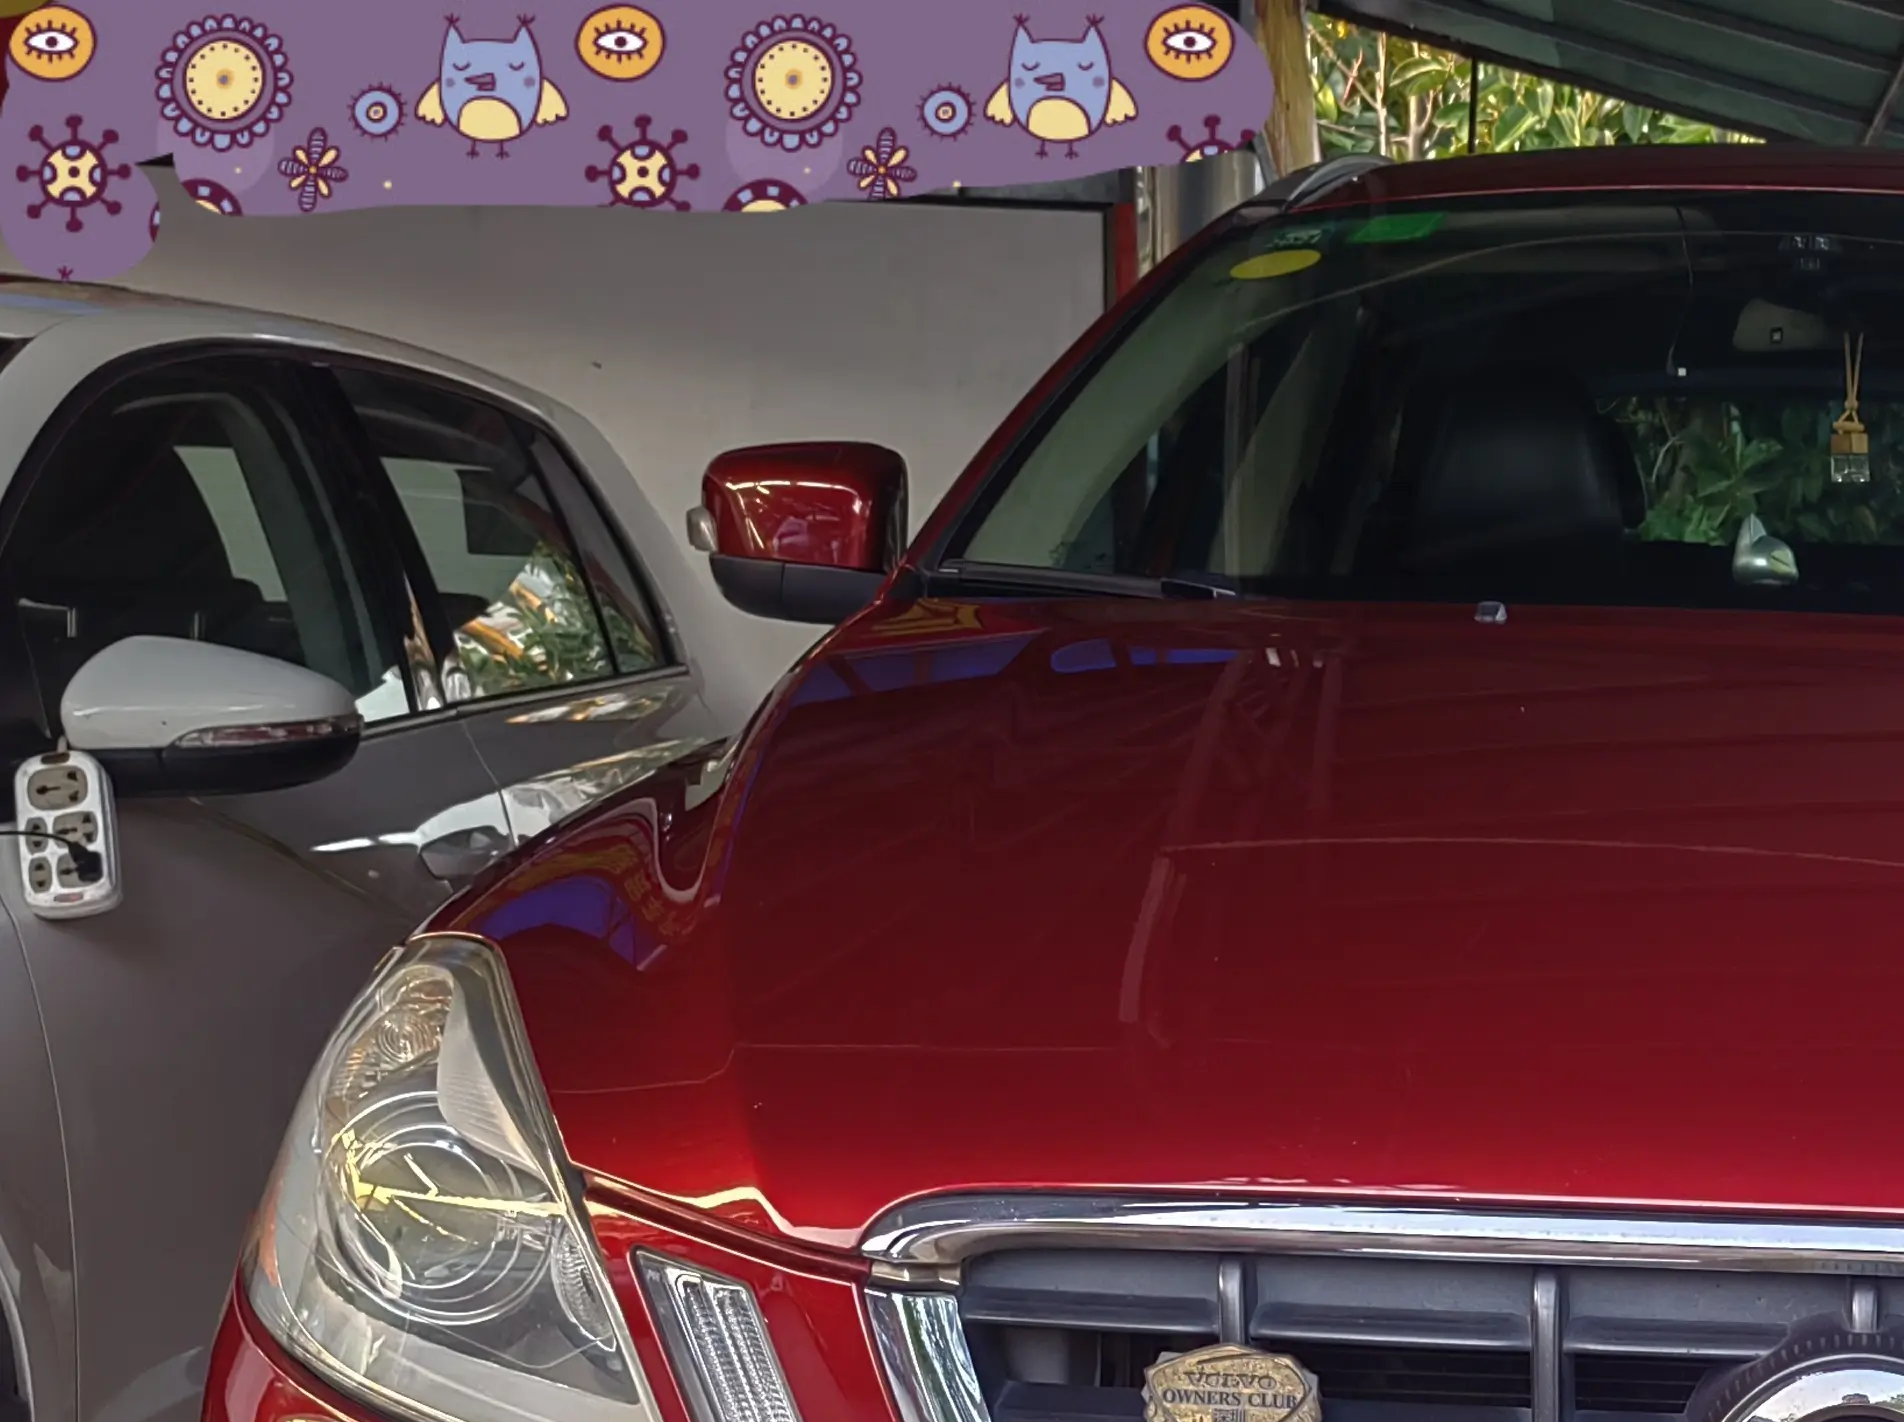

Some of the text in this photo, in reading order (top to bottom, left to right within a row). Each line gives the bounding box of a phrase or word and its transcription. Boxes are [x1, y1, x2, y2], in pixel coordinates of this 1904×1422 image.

[1183, 1371, 1277, 1390] VOLVO
[1162, 1388, 1298, 1409] OWNERS CLUB
